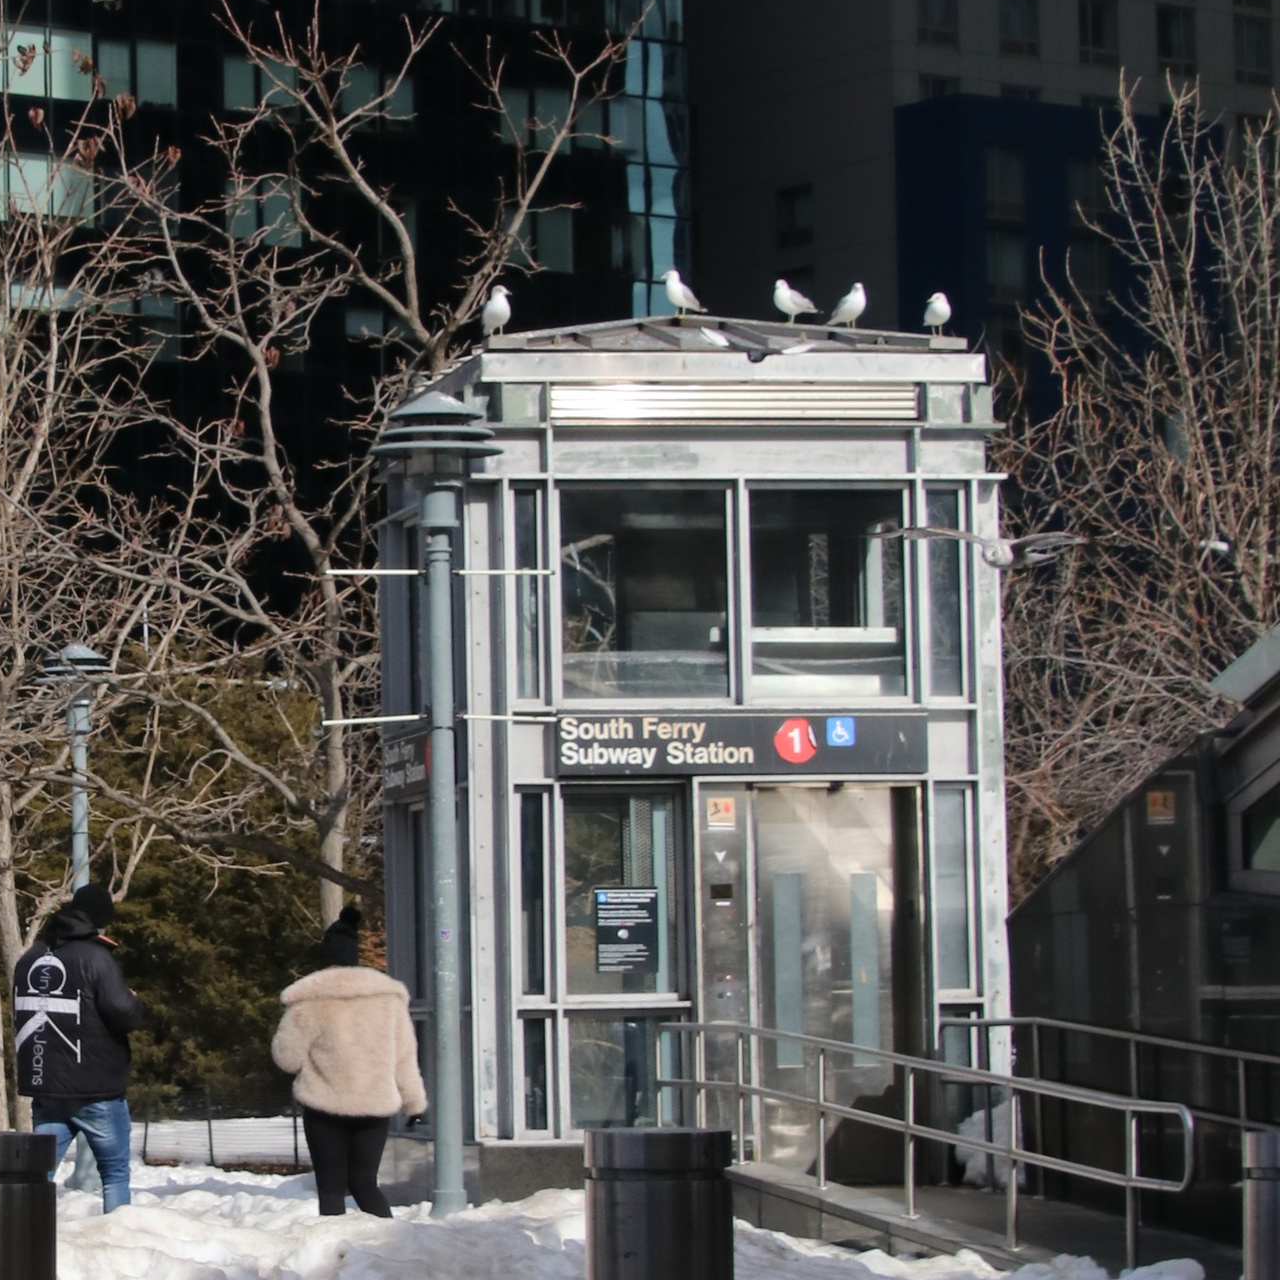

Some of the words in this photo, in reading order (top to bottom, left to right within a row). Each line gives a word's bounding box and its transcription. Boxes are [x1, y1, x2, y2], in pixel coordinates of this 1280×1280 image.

[560, 717, 633, 740] South
[642, 717, 705, 743] Ferry
[787, 727, 801, 754] 1
[560, 741, 656, 768] Subway
[666, 741, 754, 765] Station
[32, 1034, 47, 1085] Jeans
